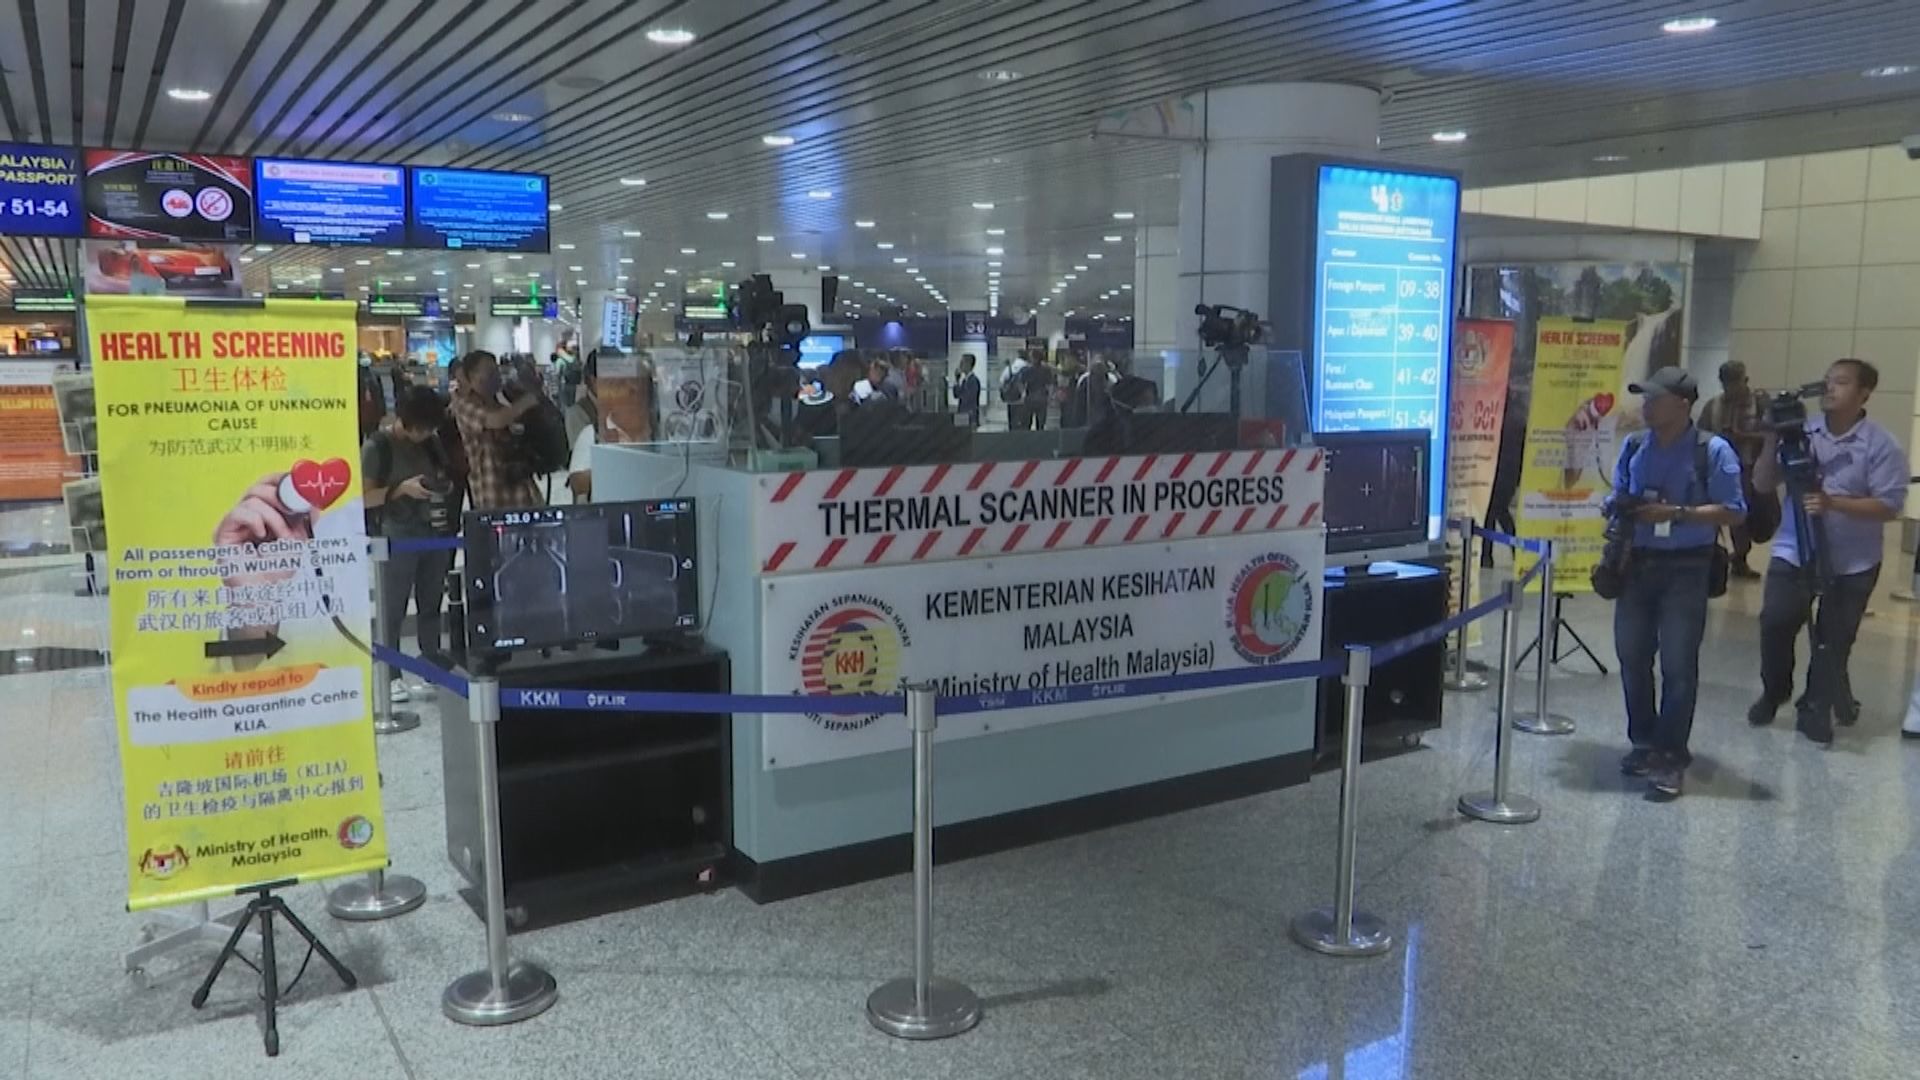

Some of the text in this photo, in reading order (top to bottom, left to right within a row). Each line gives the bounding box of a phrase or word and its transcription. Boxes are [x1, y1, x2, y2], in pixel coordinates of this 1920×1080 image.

[11, 198, 70, 217] 51-54
[100, 332, 345, 361] HEALTH SCREENING
[171, 365, 288, 392] 卫生体检
[107, 398, 347, 417] FOR PNEUMONIA OF UNKNOWN
[208, 418, 258, 431] CAUSE
[149, 435, 313, 457] 为防范武汉不明肺炎
[819, 475, 1284, 537] THERMAL SCANNER IN PROGRESS
[124, 537, 349, 564] All passengers & cabin crews
[115, 567, 152, 580] from
[158, 567, 173, 578] or
[178, 562, 239, 578] through
[310, 553, 357, 567] CHINA
[926, 566, 1216, 620] KEMENTERIAN KESIHATAN
[789, 603, 829, 661] KESIHATAN
[832, 593, 893, 616] SEPANJANG
[1024, 613, 1133, 651] MALAYSIA
[1028, 662, 1051, 690] of
[1056, 656, 1120, 686] Health
[1127, 640, 1216, 676] Malaysia)
[193, 673, 303, 698] Kindly report to
[1032, 688, 1067, 704] KKM
[134, 688, 358, 724] The Health Quarantine Centre
[520, 690, 626, 707] KKM FLIR
[823, 712, 885, 732] SEPANJAN
[225, 745, 286, 769] 请前往
[196, 839, 257, 858] Ministry
[261, 835, 277, 849] of
[231, 847, 302, 868] Malaysia
